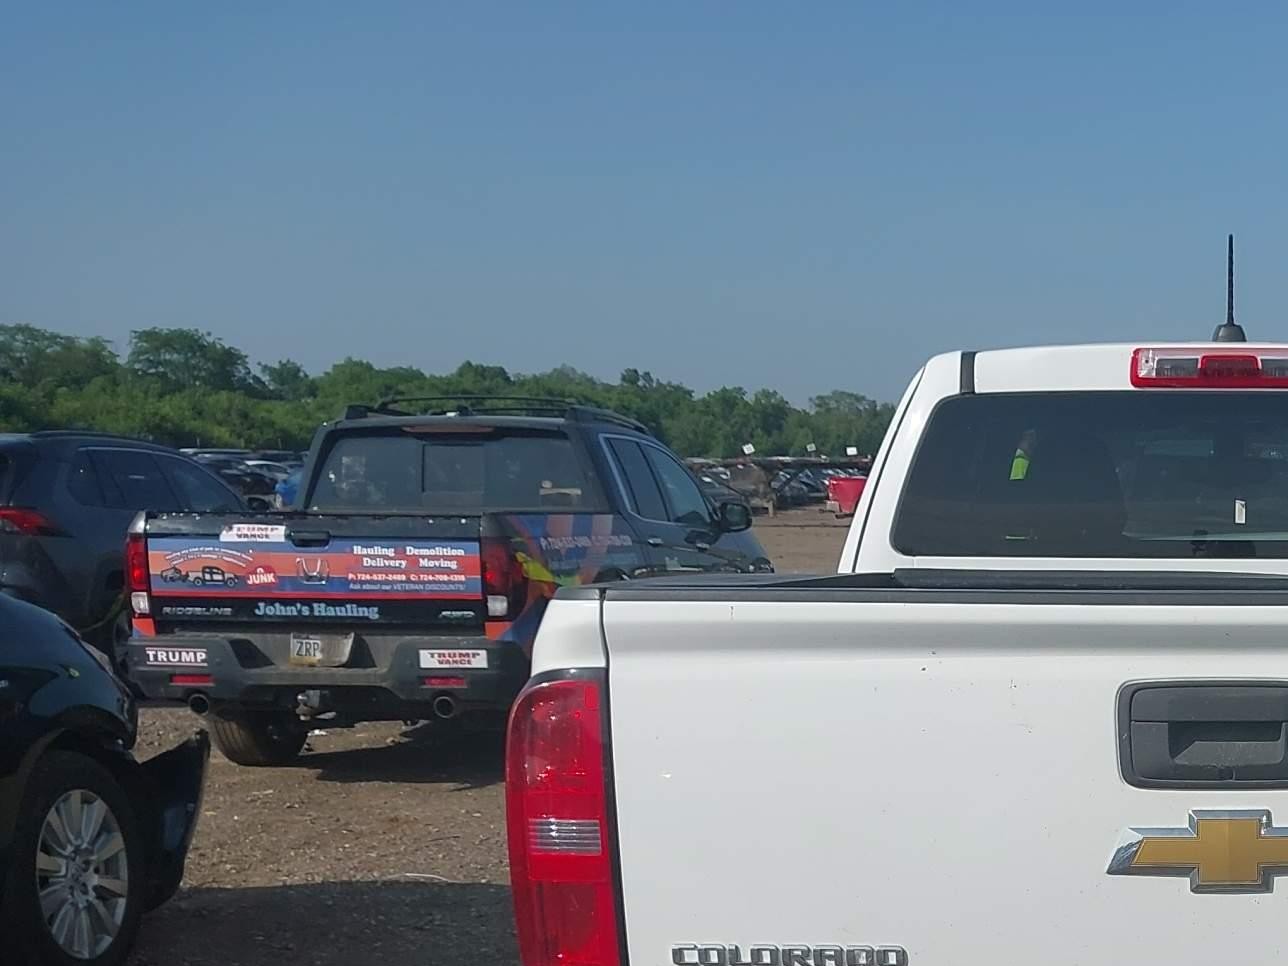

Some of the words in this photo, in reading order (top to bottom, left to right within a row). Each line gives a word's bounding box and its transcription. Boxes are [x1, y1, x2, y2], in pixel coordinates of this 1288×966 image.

[353, 546, 395, 557] Hauling
[406, 546, 465, 556] Demolition
[363, 557, 407, 569] Delivery
[418, 558, 458, 569] Moving
[247, 573, 276, 585] JUNK
[162, 607, 232, 616] RIDGELINE
[255, 602, 309, 617] John's
[313, 603, 379, 619] Hauling
[296, 640, 320, 657] ZRP
[146, 650, 207, 662] TRUMP
